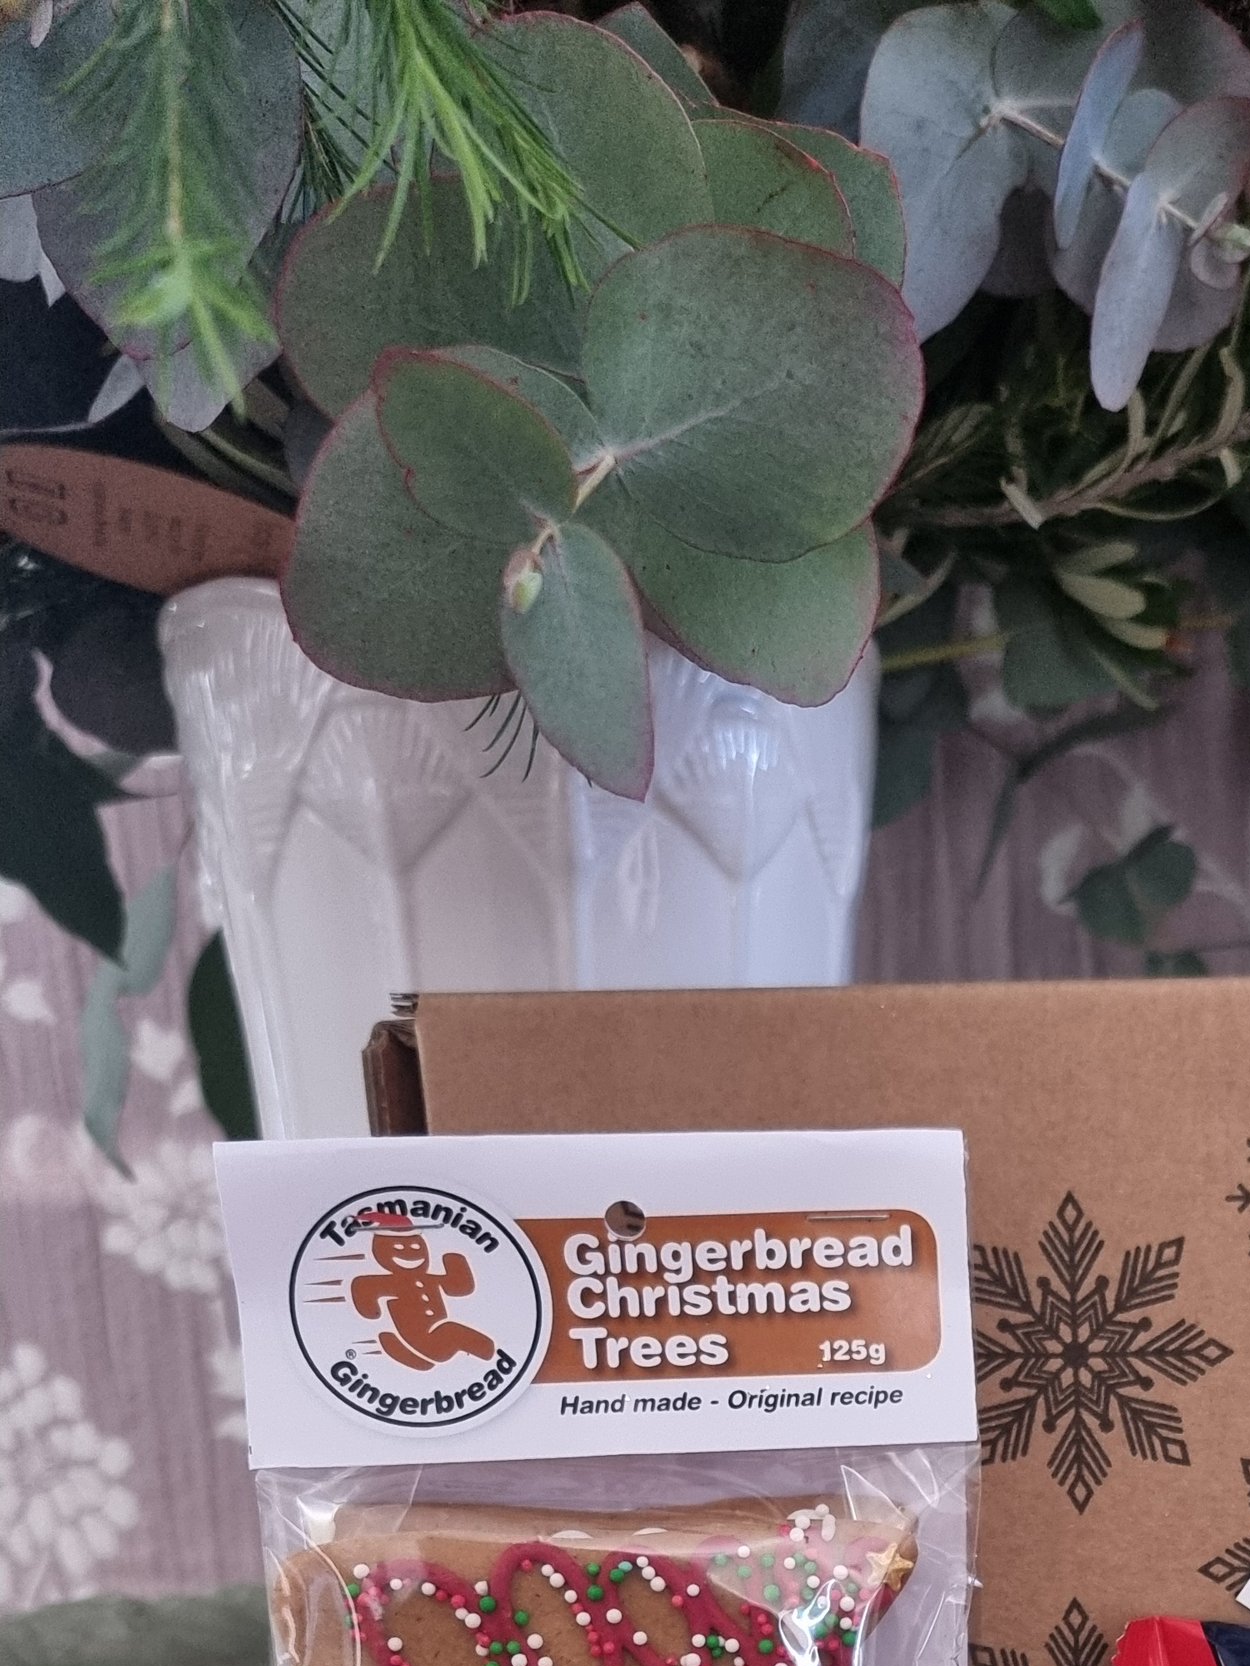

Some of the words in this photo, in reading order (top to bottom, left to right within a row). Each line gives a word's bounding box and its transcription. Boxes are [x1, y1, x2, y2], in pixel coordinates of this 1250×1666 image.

[563, 1224, 914, 1284] Gingerbread
[566, 1275, 852, 1320] Christmas
[568, 1326, 730, 1370] Trees
[818, 1339, 886, 1366] 125g
[329, 1348, 518, 1417] Gingerbread
[560, 1394, 626, 1416] Hand
[633, 1391, 702, 1413] made
[727, 1386, 824, 1414] Original
[830, 1385, 904, 1409] recipe
